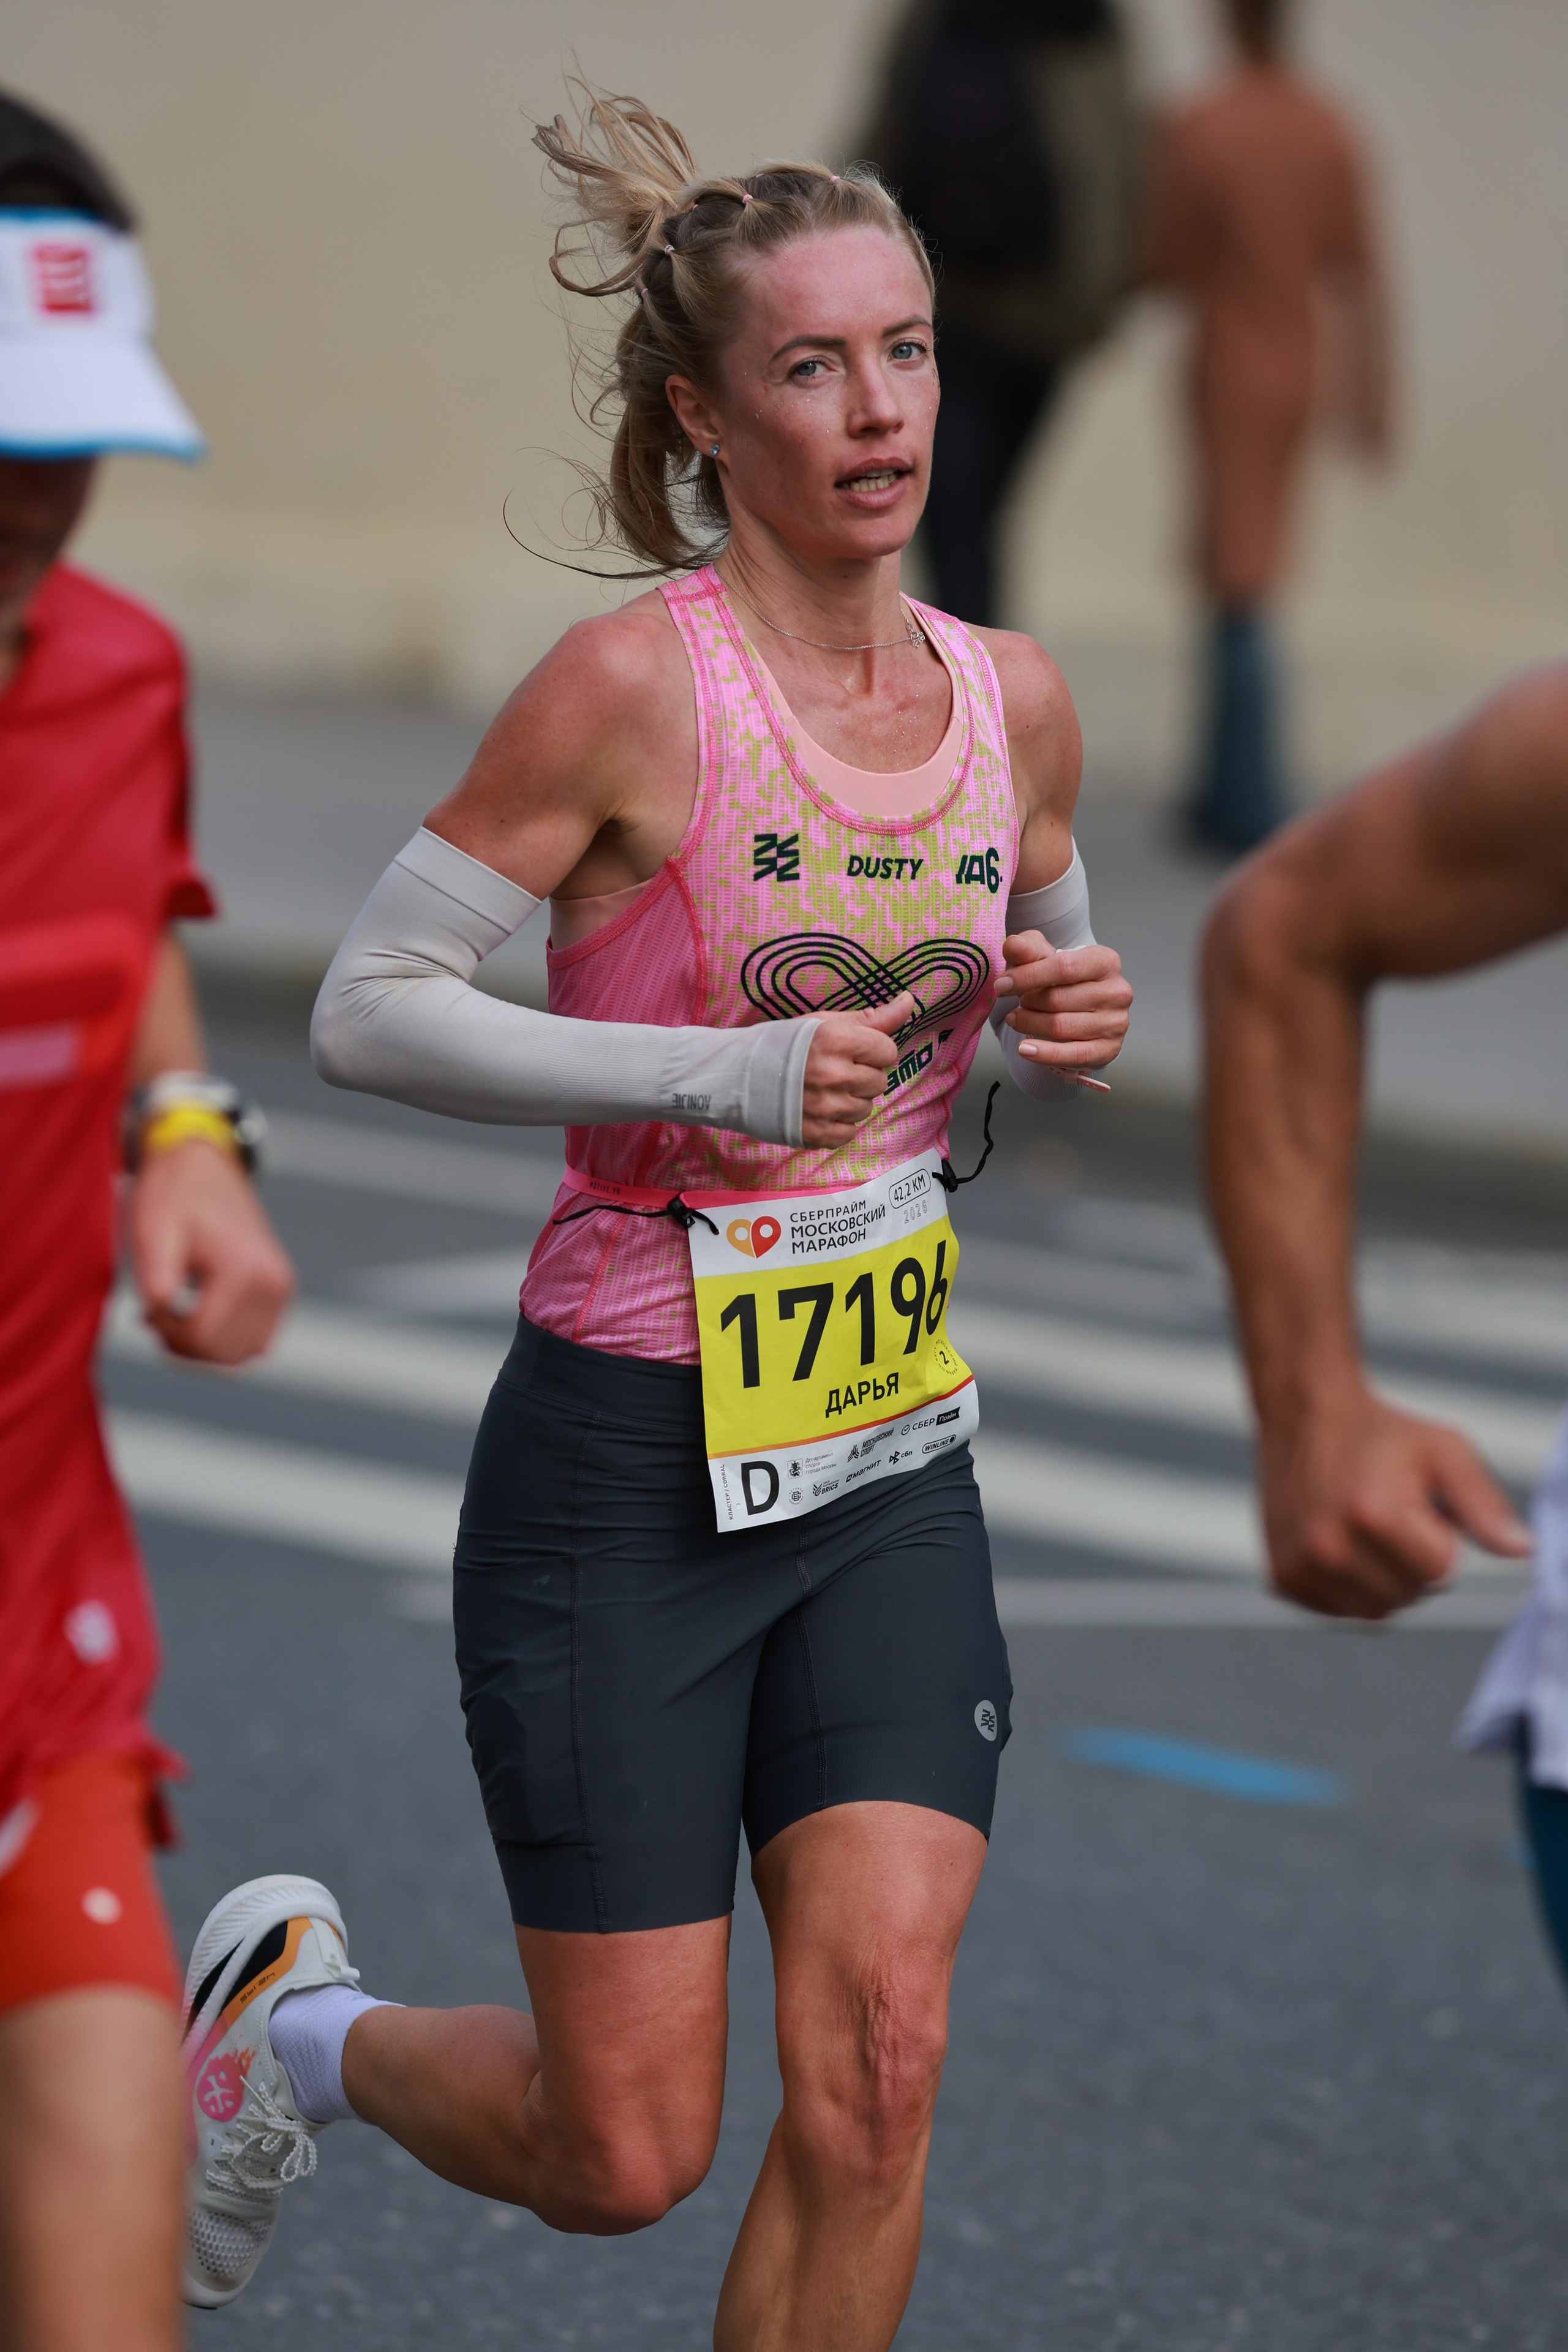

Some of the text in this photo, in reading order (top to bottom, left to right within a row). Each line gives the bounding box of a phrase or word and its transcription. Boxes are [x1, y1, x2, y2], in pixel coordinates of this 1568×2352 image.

[847, 854, 924, 880] DUSTY
[672, 1093, 711, 1110] AONIJIE
[894, 1183, 911, 1202] 42,2
[790, 1200, 866, 1223] СБЕРПРАЙМ
[791, 1203, 886, 1239] МОСКОВСКИЙ
[903, 1200, 928, 1224] 2026
[792, 1228, 866, 1254] МАРАФОН
[720, 1239, 948, 1389] 17196
[939, 1351, 950, 1365] 2
[825, 1372, 899, 1418] ДАРЬЯ
[912, 1412, 957, 1430] СБЕР Прайм
[862, 1427, 894, 1449] МОСКОВСКИЙ
[925, 1439, 949, 1452] WINLINE
[860, 1444, 876, 1458] СПОРТ
[741, 1461, 780, 1516] D
[821, 1482, 839, 1494] BRICS
[725, 1493, 734, 1520] КЛАСТЕР
[240, 1972, 275, 2003] 42.195
